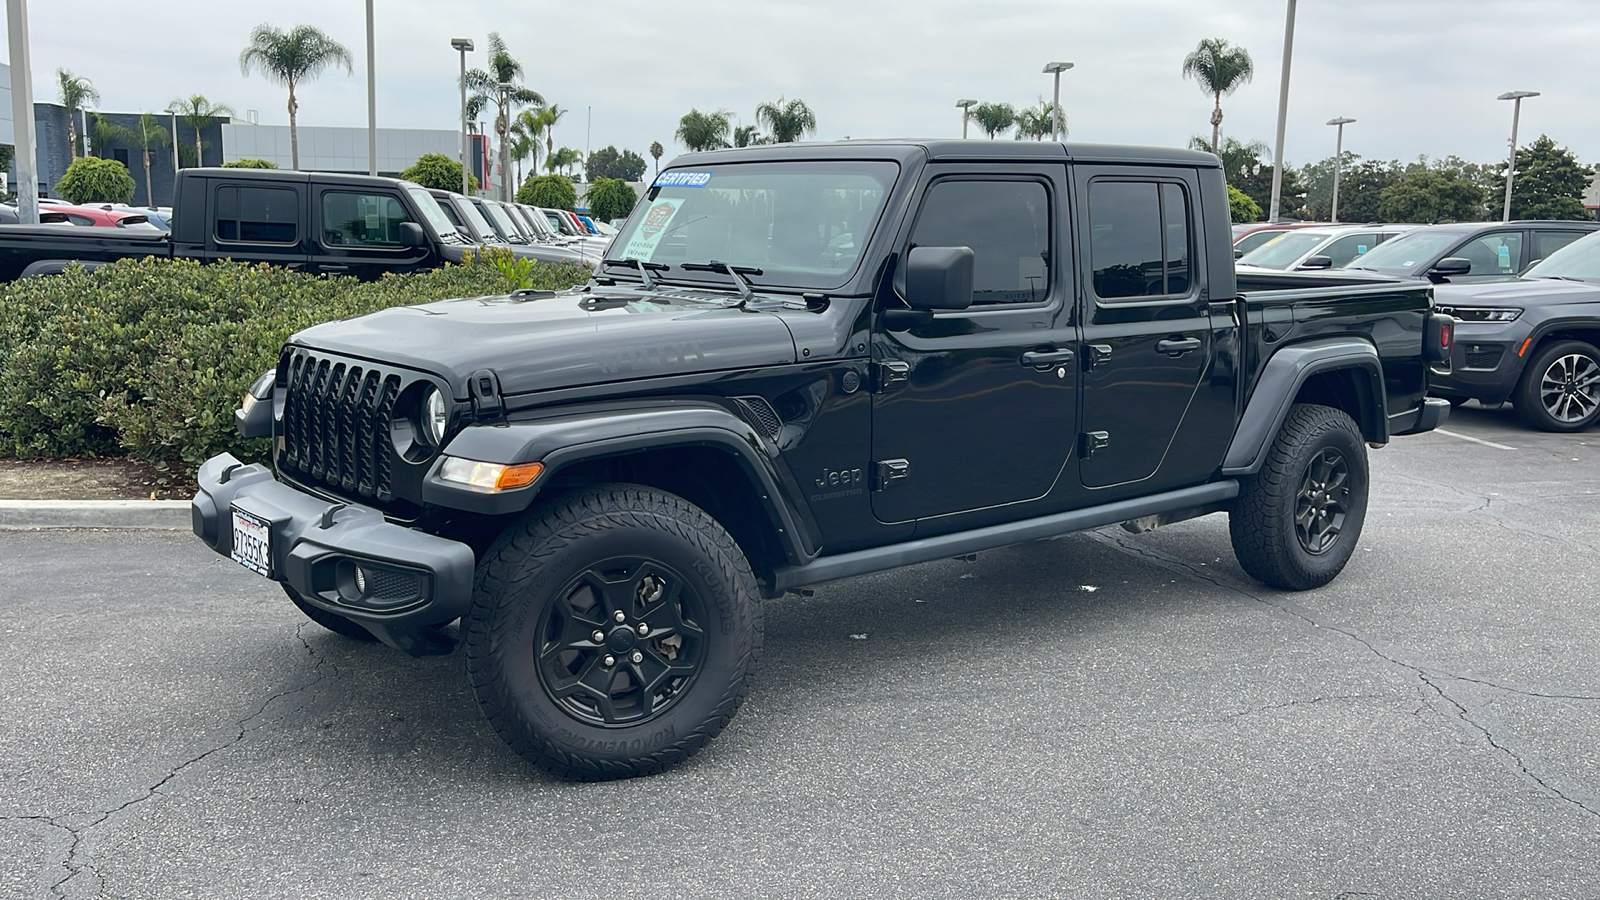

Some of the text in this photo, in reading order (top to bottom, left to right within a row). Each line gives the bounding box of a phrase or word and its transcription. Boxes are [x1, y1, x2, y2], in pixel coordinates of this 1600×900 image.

[656, 171, 711, 186] CERTIFIED
[815, 467, 863, 489] Jeep
[810, 488, 863, 502] GLADIATOR
[233, 527, 270, 567] 97355K3
[691, 557, 736, 636] KUMHO
